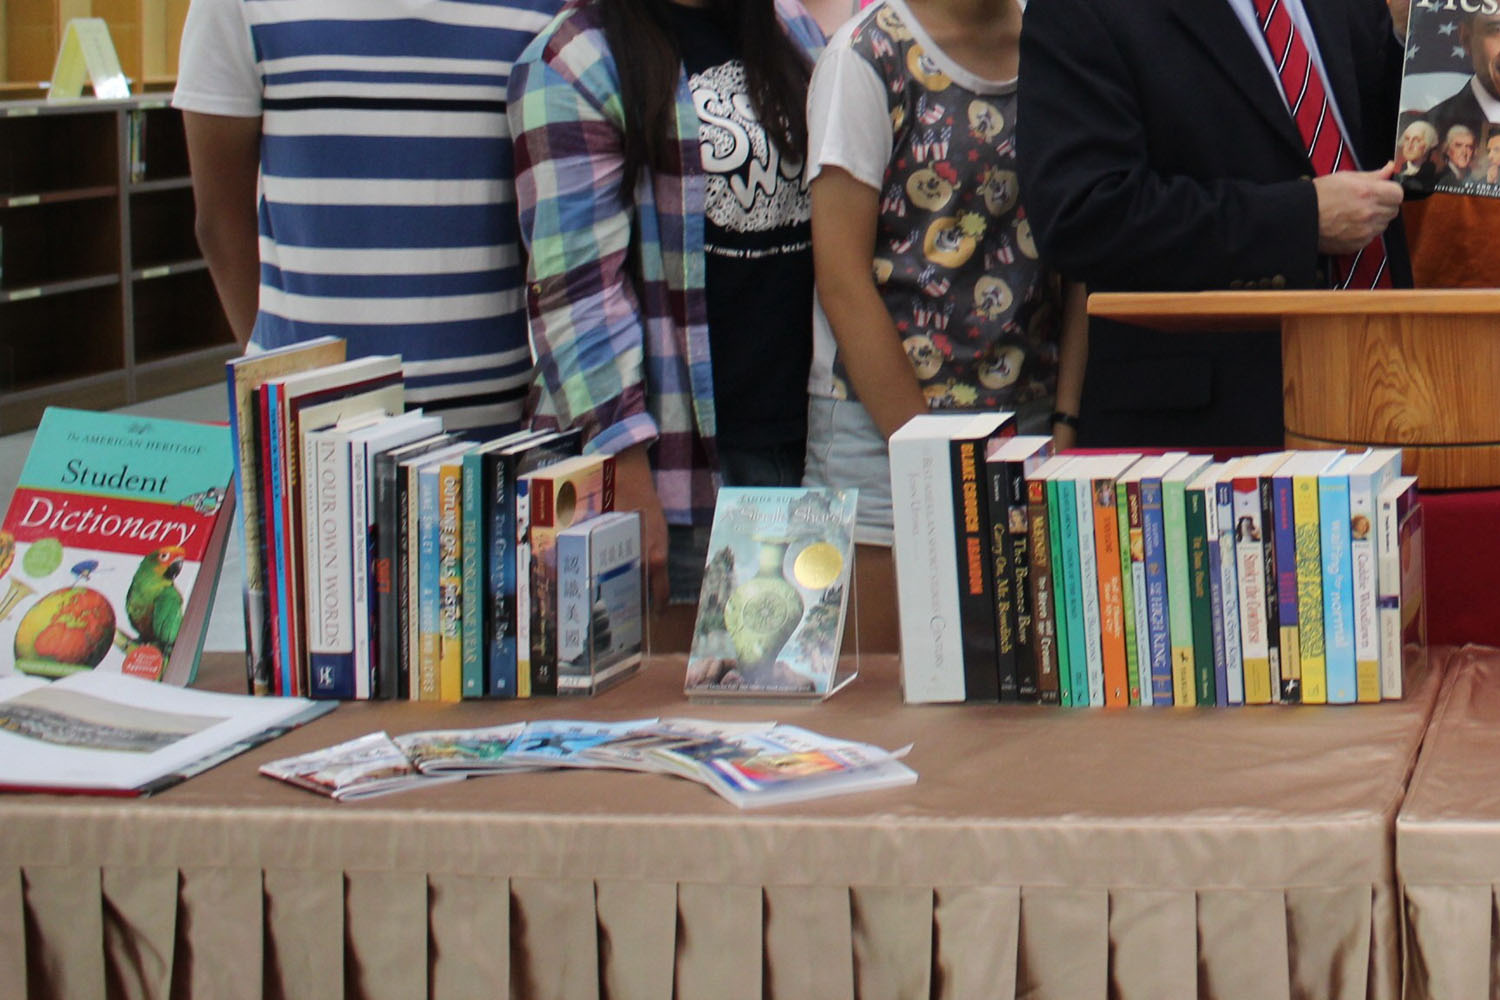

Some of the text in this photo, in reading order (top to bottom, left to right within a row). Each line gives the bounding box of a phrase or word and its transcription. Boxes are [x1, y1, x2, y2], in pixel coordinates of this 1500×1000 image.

[82, 434, 143, 450] AMERICAN
[146, 438, 205, 455] HERITAGE
[61, 459, 169, 494] Student
[20, 496, 197, 547] Dictionary
[443, 476, 456, 533] OUTLINE
[321, 441, 340, 647] IN OUR OWN WORDS
[423, 515, 433, 555] SMILEY
[443, 534, 456, 553] OF
[991, 523, 1005, 555] Carry
[444, 583, 456, 638] HISTORY
[464, 519, 477, 664] THE PORCUPINE YEAR
[563, 553, 582, 649] 認識美國
[1014, 539, 1031, 644] The Bronze Bow
[1151, 597, 1167, 667] HIGH KING
